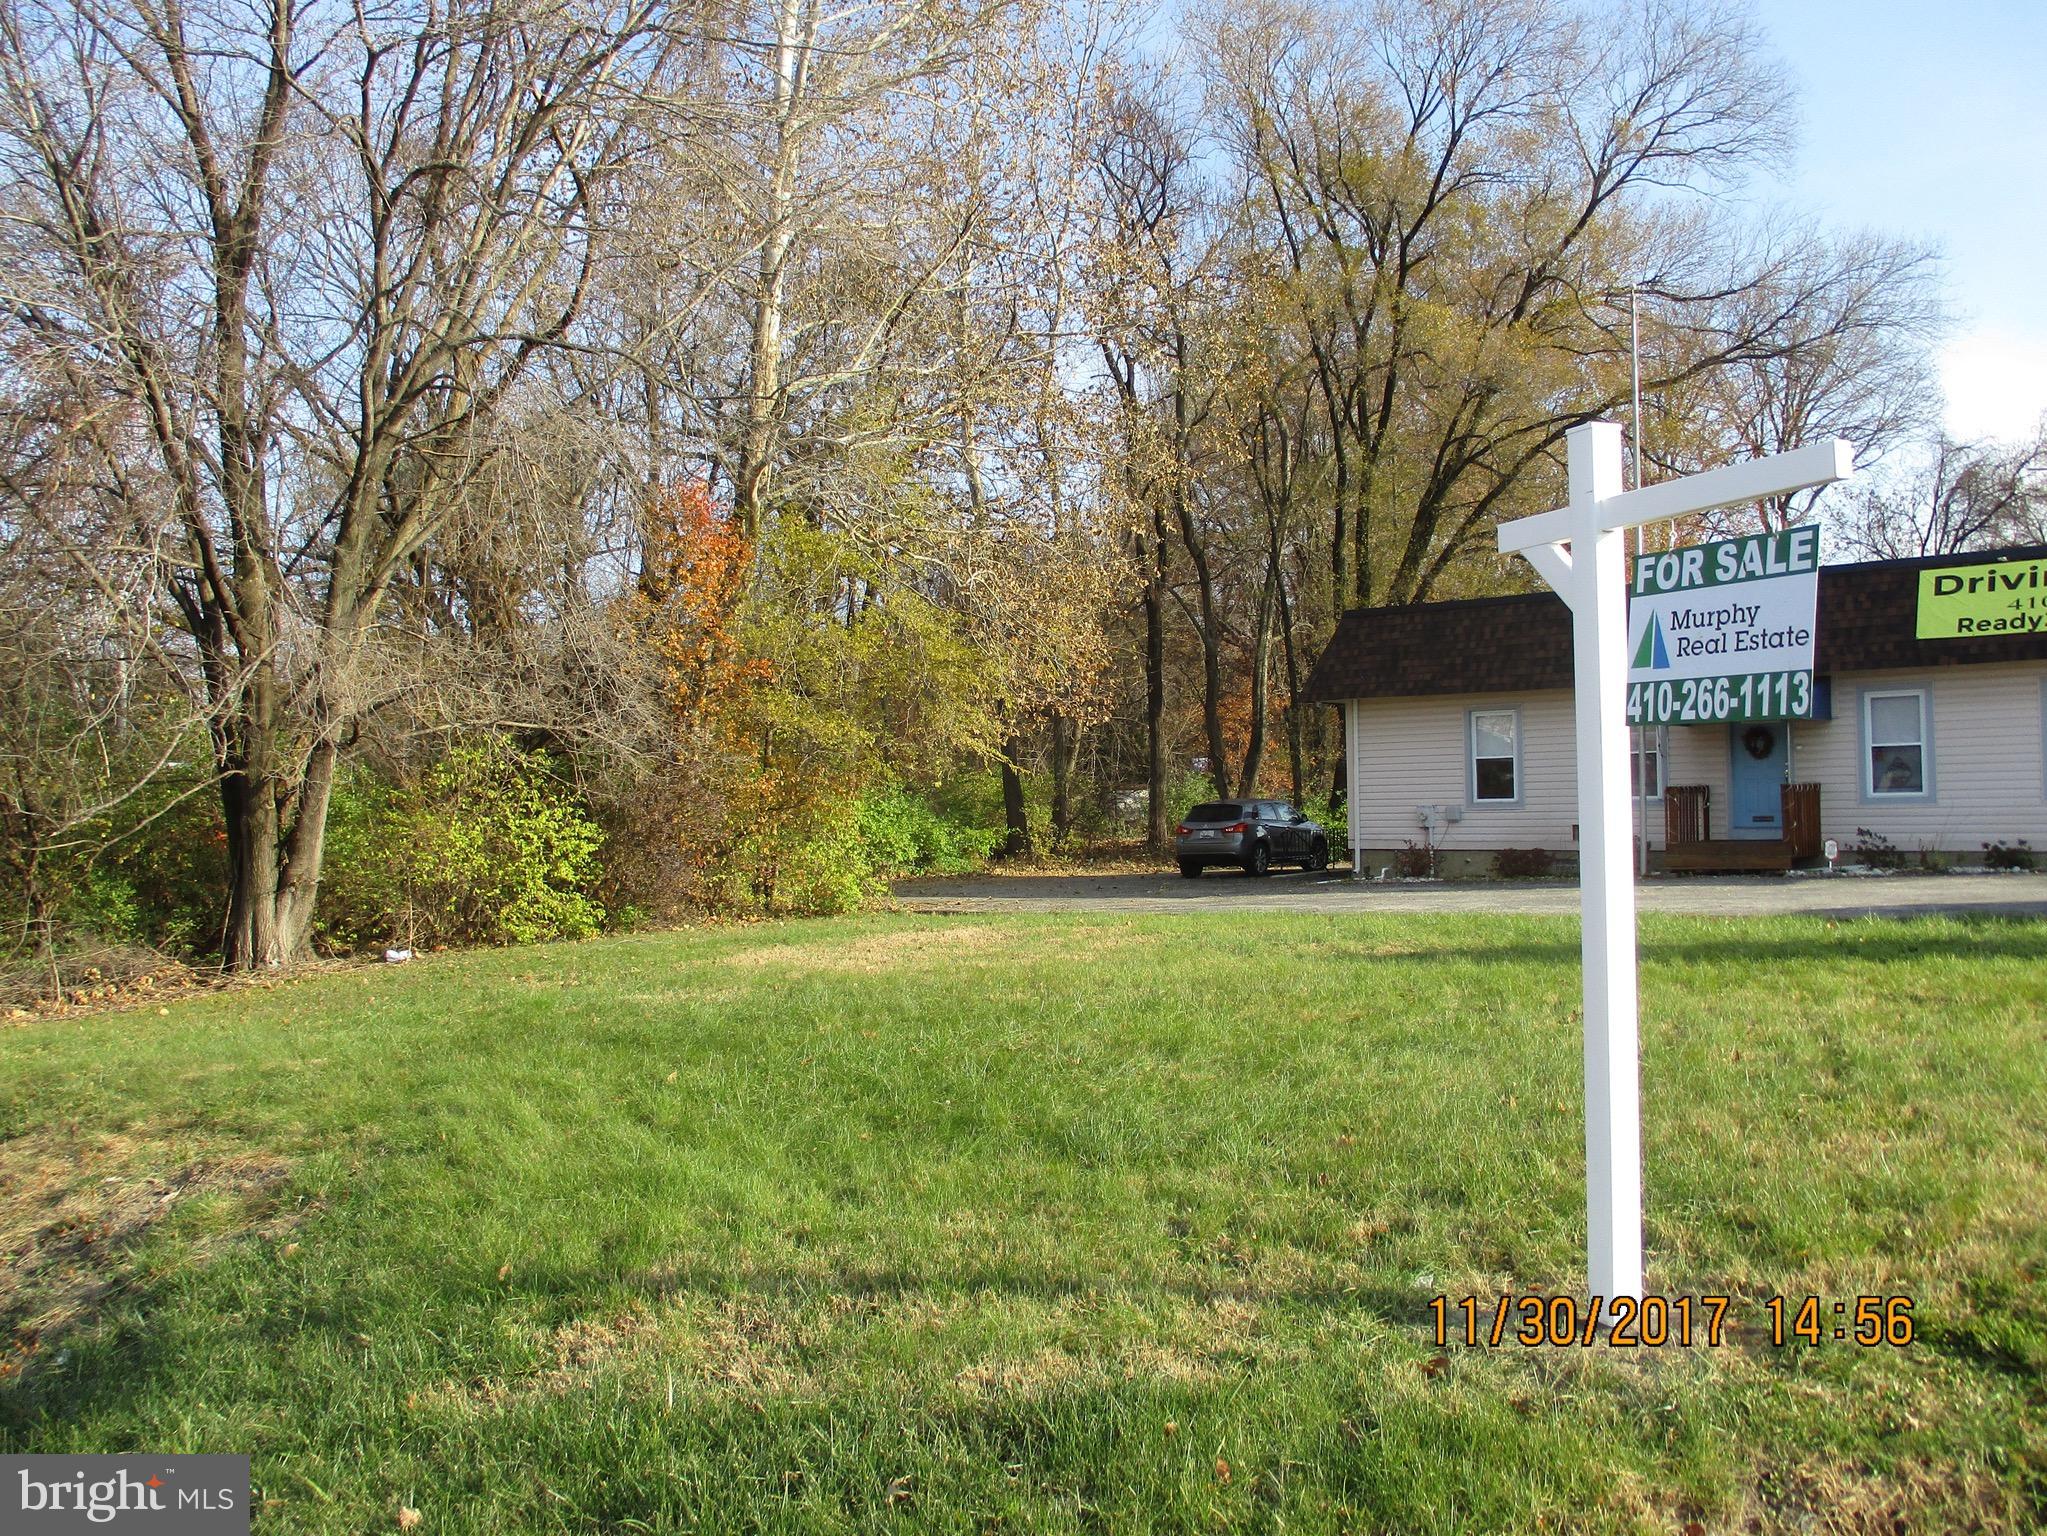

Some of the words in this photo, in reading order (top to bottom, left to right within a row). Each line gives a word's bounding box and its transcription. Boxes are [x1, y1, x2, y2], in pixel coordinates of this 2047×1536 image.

[1636, 549, 1704, 593] FOR
[1715, 530, 1813, 582] SALE
[1934, 565, 2047, 596] Drivi
[1670, 603, 1761, 631] Murphy
[1957, 612, 2047, 633] Ready
[1676, 633, 1727, 658] Real
[1734, 625, 1809, 652] Estate
[1627, 671, 1809, 722] 410-266-1113
